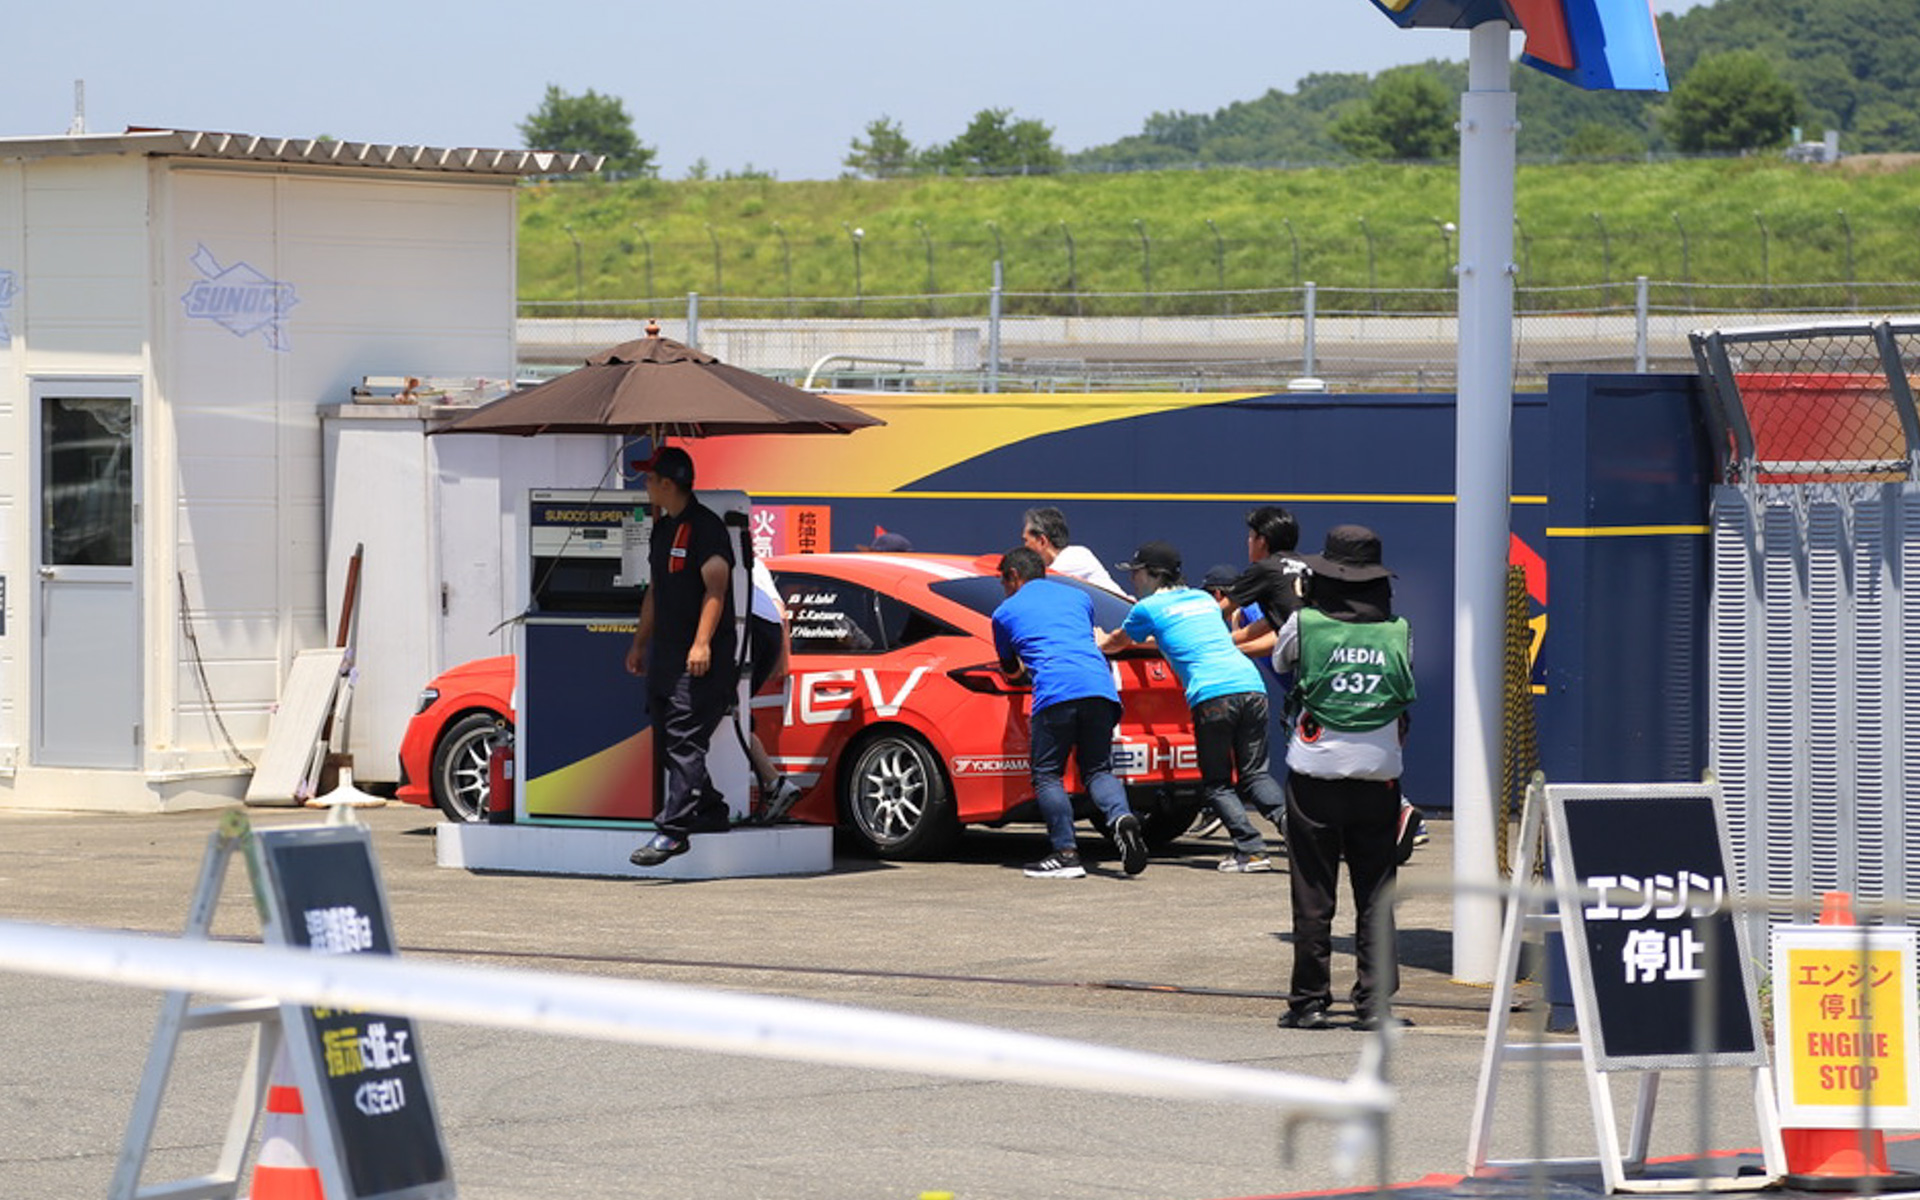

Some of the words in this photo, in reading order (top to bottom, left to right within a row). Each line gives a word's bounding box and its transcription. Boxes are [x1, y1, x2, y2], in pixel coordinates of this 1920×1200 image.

[190, 286, 292, 313] SUNOCO
[545, 510, 587, 521] SUNOCO
[590, 510, 624, 521] SUPER
[1329, 647, 1386, 666] MEDIA
[1331, 672, 1383, 694] 637
[1585, 871, 1723, 920] エンジン
[1622, 928, 1706, 983] 停止
[1798, 964, 1893, 988] エンジン
[1819, 993, 1873, 1020] 停止
[1807, 1032, 1889, 1058] ENGINE
[1820, 1064, 1879, 1090] STOP
